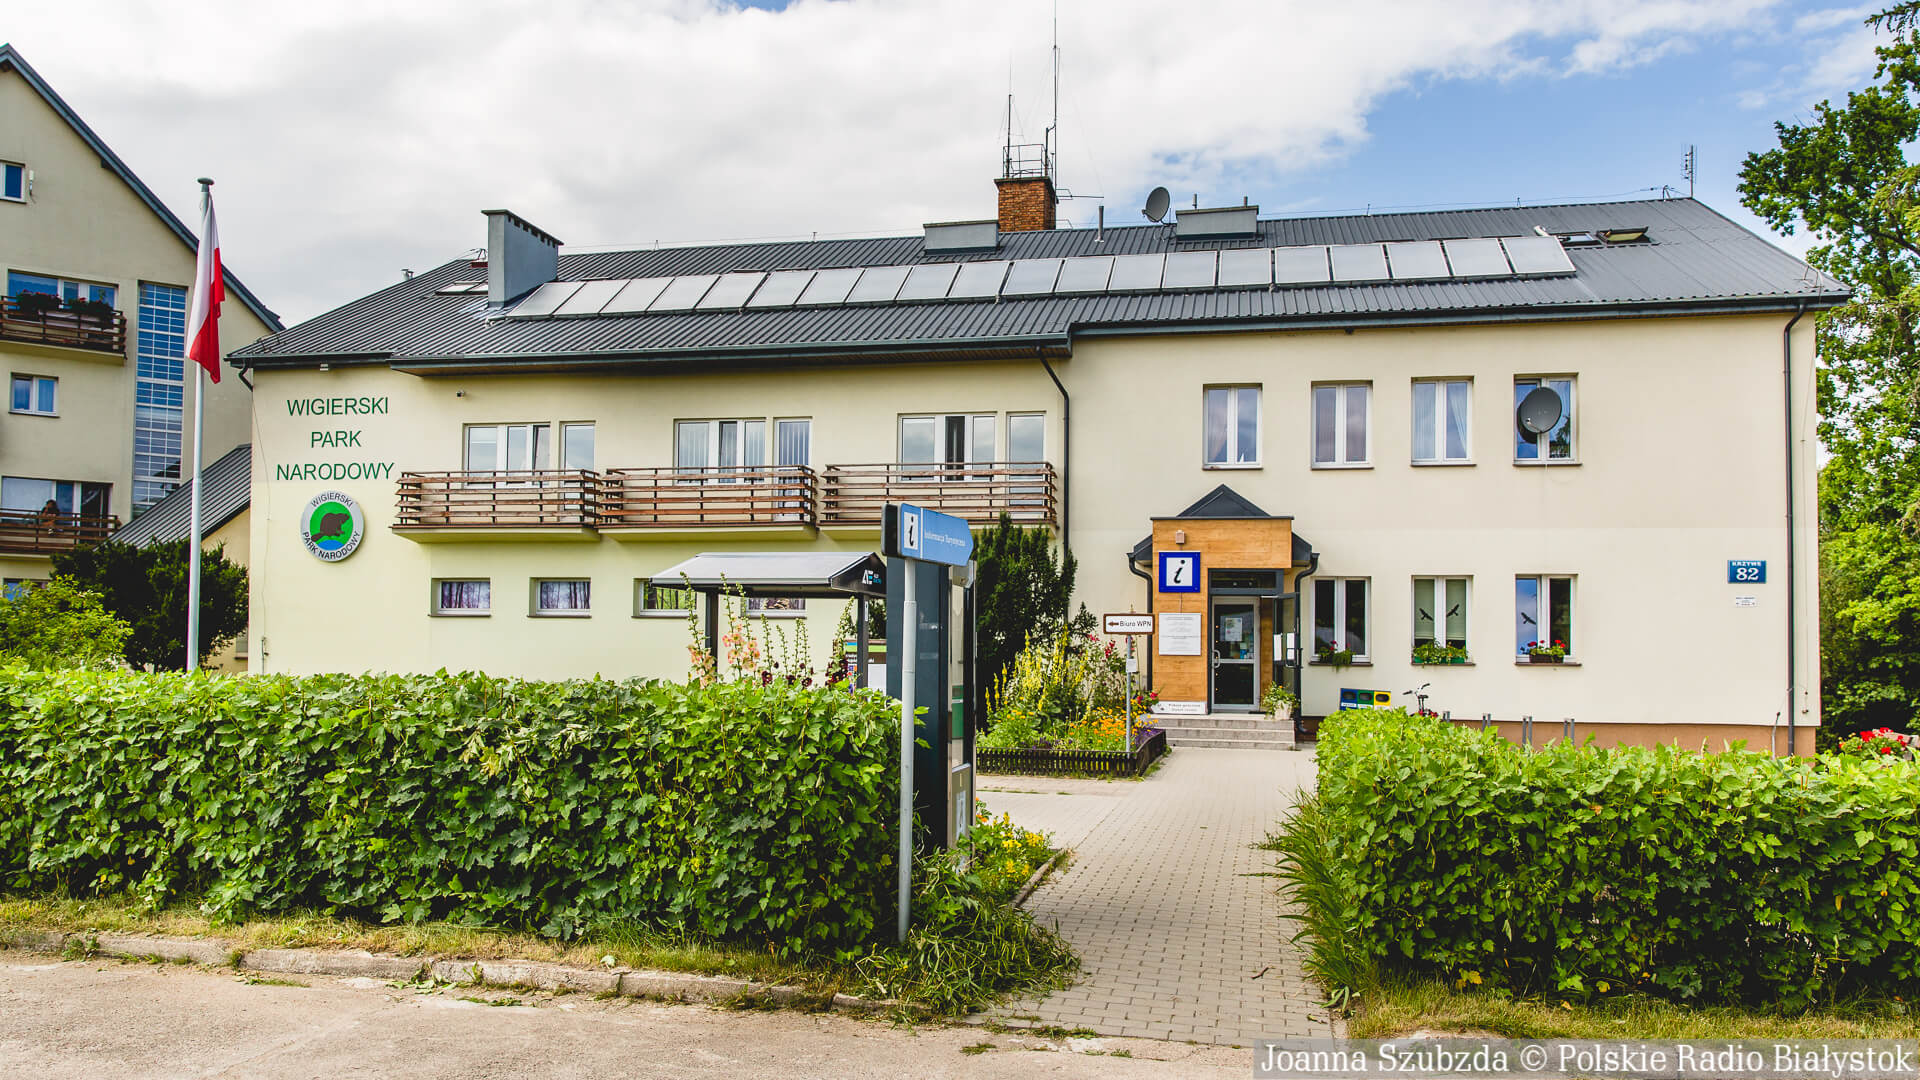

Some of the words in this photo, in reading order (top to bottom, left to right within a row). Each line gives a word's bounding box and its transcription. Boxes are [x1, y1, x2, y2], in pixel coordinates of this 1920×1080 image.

[286, 397, 389, 417] WIGIERSKI
[311, 430, 362, 449] PARK
[276, 462, 395, 481] NARODOWY
[311, 492, 353, 508] WIGIERSKI
[303, 531, 319, 554] PARK
[318, 530, 361, 560] NARODOWY
[1736, 567, 1760, 581] 82
